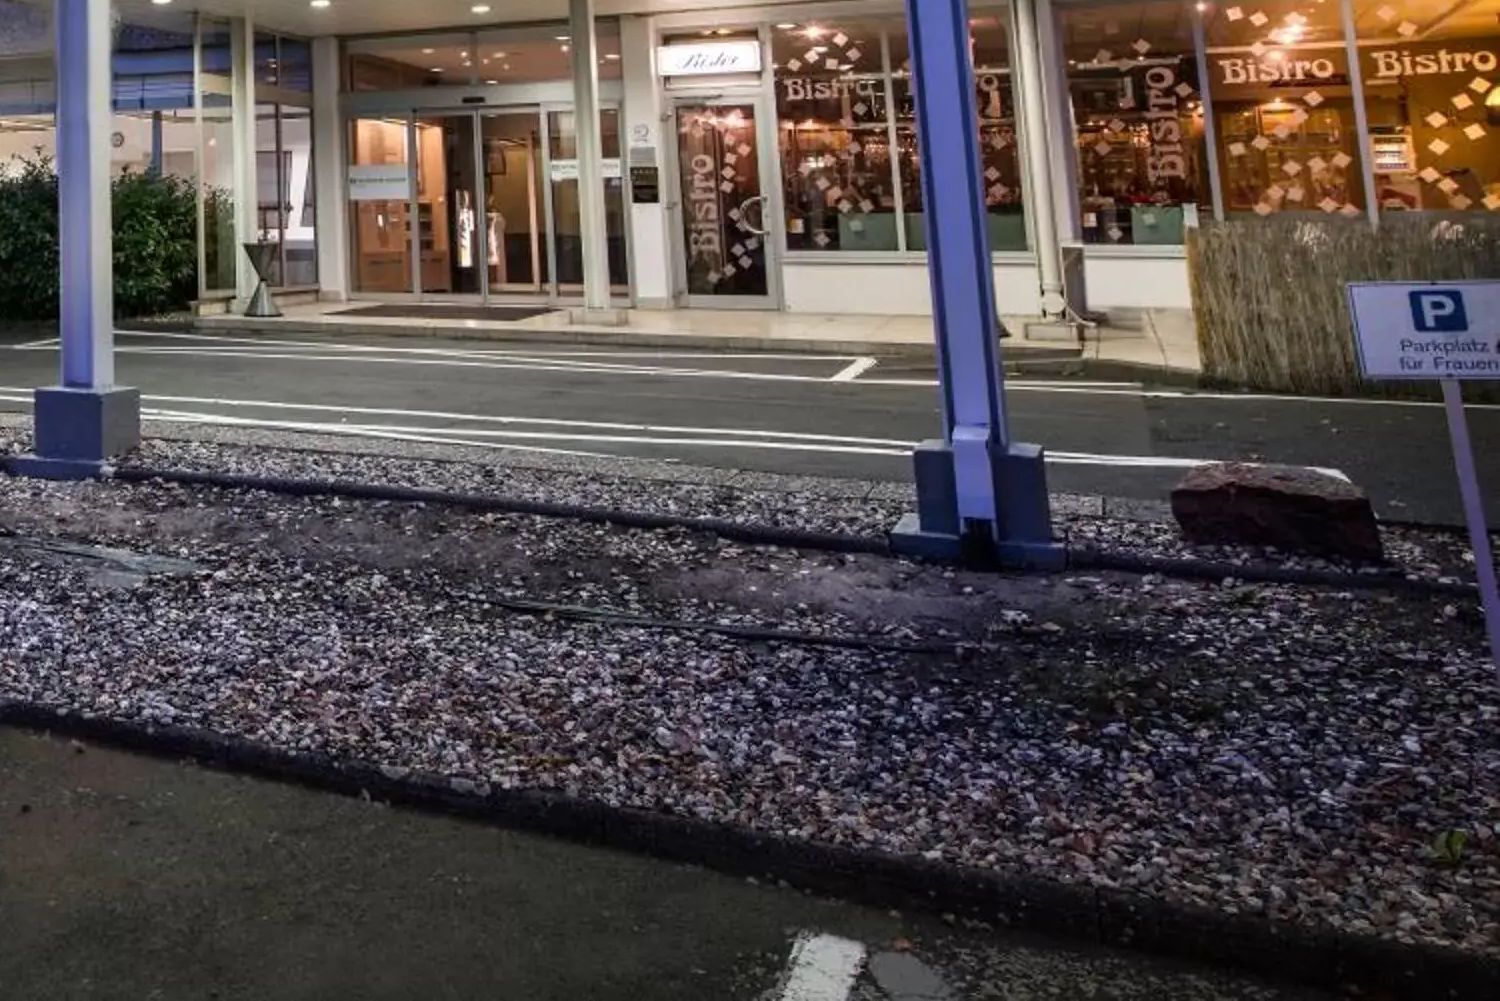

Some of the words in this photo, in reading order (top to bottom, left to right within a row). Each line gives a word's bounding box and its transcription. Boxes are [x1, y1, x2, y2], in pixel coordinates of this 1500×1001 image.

[1219, 56, 1335, 85] Bistro
[1370, 48, 1497, 79] Bistro
[784, 76, 873, 101] Bistro
[1145, 65, 1187, 181] Bistro
[690, 154, 721, 256] Bistro
[1420, 294, 1455, 328] P
[1400, 338, 1490, 357] Parkplatz
[1400, 356, 1424, 370] für
[1434, 356, 1500, 371] Frauen
